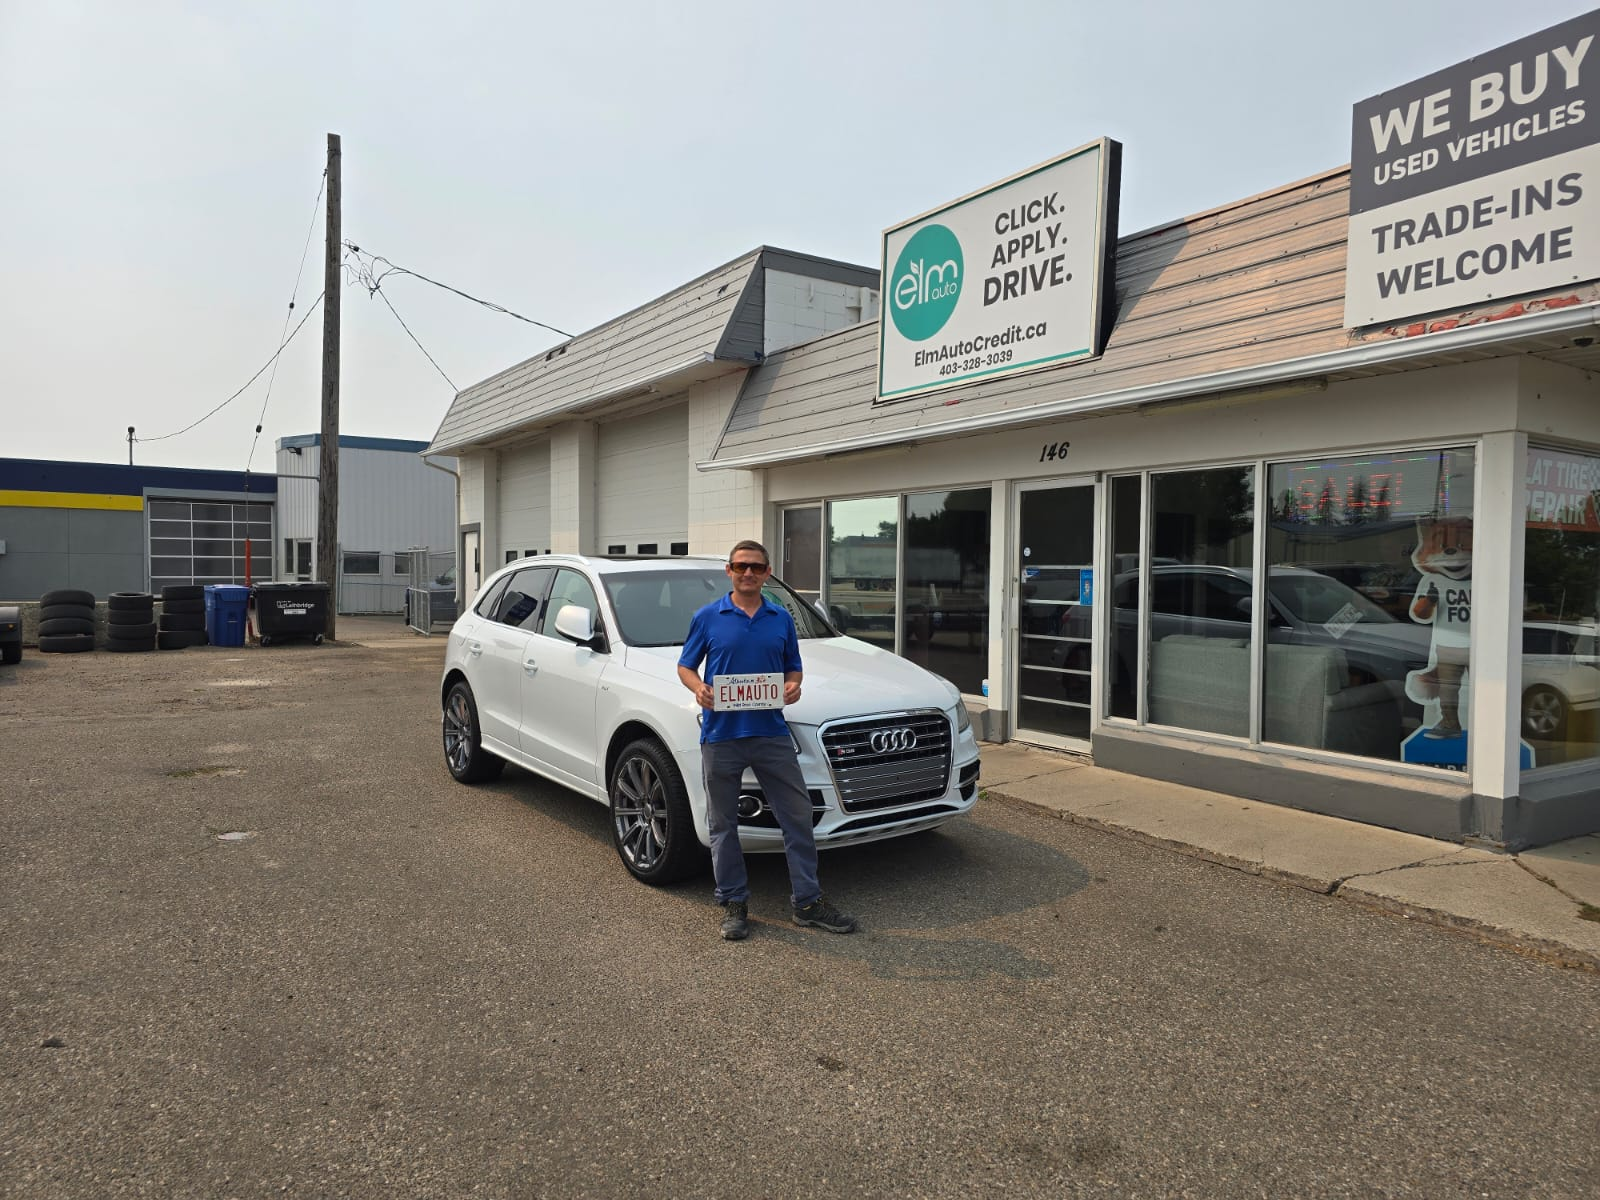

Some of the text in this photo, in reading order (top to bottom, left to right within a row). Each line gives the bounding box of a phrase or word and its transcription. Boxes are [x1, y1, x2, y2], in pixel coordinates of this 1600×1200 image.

[1369, 34, 1595, 155] WE BUY
[1374, 99, 1586, 186] USED VEHICLES
[995, 192, 1065, 235] CLICK.
[1371, 172, 1583, 254] TRADE-INS
[990, 222, 1068, 269] APPLY.
[1376, 226, 1573, 299] WELCOME
[894, 257, 958, 310] elm
[931, 281, 957, 300] auto
[983, 254, 1073, 307] DRIVE.
[914, 321, 1047, 367] ElmAutoCredit.ca
[939, 349, 1013, 376] 403-328-3039
[1039, 441, 1070, 462] 146
[1446, 589, 1471, 605] CA
[1447, 606, 1471, 622] FO
[720, 684, 778, 702] ELMAUTO
